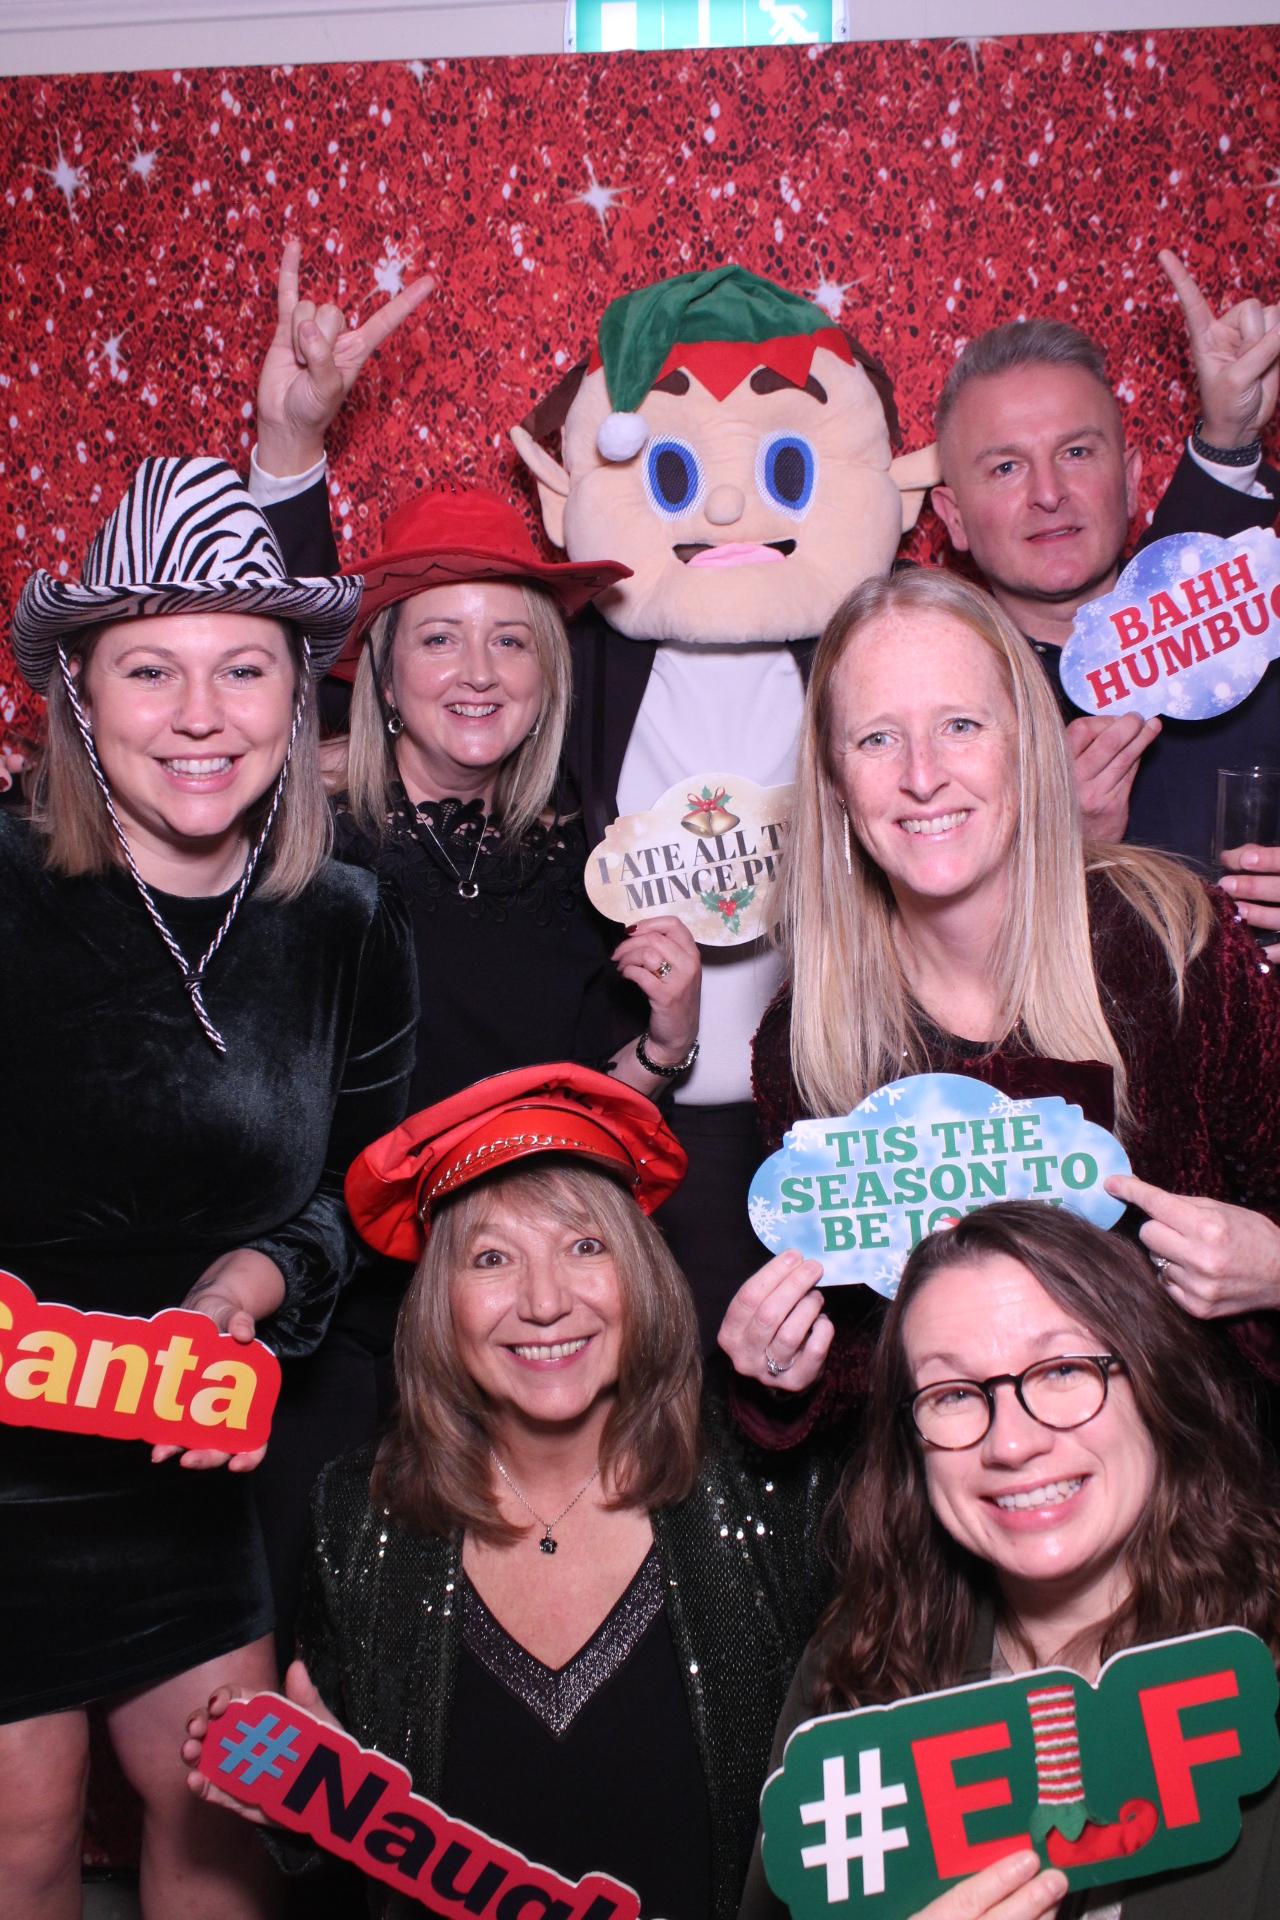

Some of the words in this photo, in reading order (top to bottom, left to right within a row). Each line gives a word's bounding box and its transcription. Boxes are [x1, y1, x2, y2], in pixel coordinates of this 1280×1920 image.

[1109, 553, 1258, 650] BAHH
[598, 856, 610, 885] I
[621, 843, 684, 881] ATE
[694, 830, 757, 866] ALL
[624, 864, 738, 911] MINCE
[741, 852, 784, 886] PI
[825, 1126, 918, 1168] TIS
[931, 1114, 1043, 1158] THE
[781, 1159, 1008, 1214] SEASON
[1023, 1152, 1098, 1193] TO
[821, 1212, 890, 1252] BE
